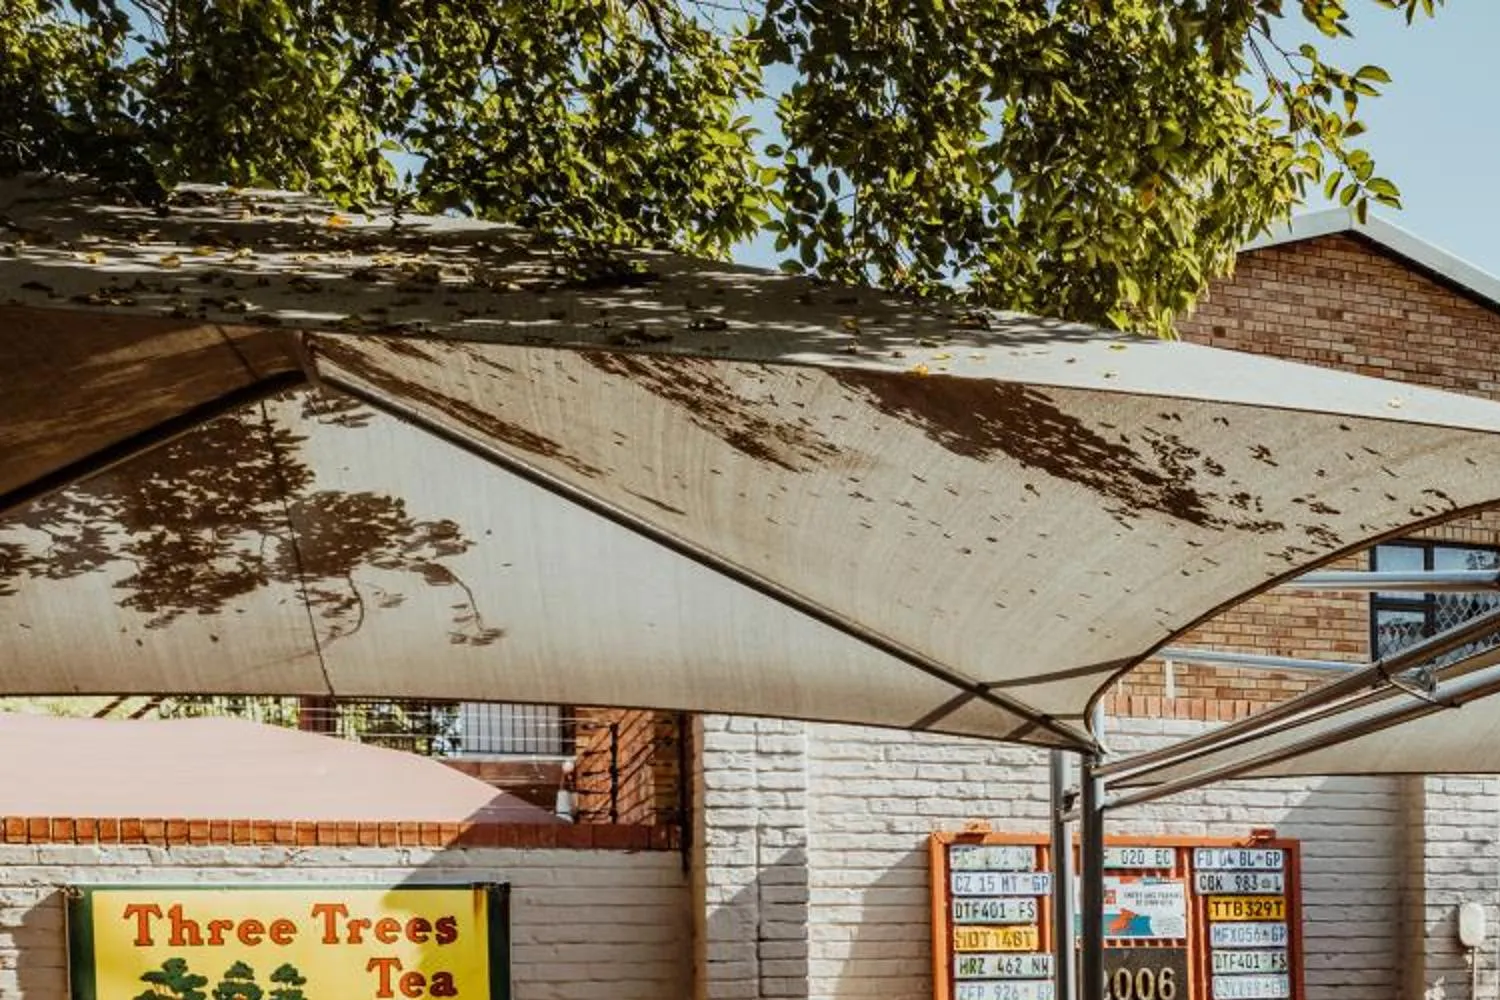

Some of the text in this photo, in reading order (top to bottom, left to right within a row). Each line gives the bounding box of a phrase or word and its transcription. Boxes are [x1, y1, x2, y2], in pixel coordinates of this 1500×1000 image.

[1265, 851, 1281, 867] GP
[123, 903, 458, 947] Three Trees
[1019, 901, 1034, 919] FS
[366, 957, 458, 999] Tea
